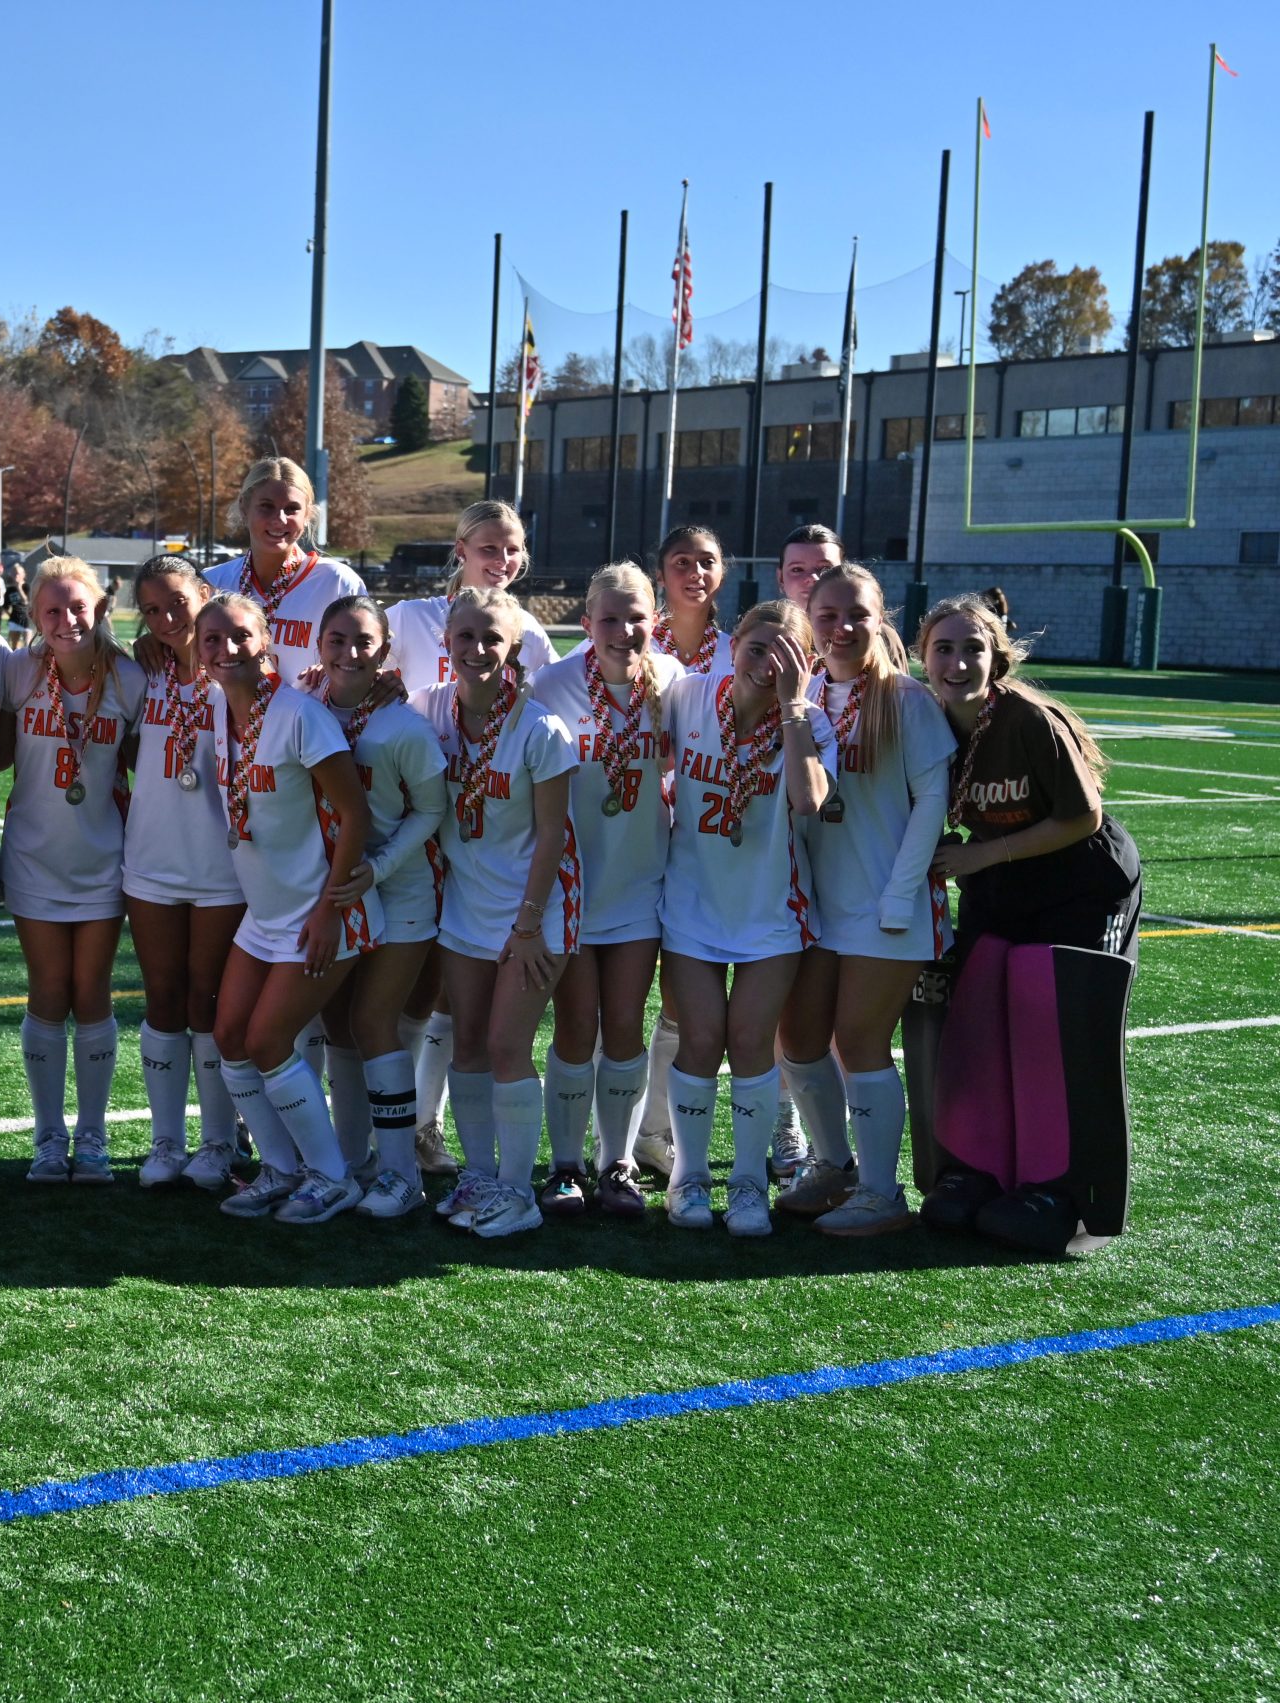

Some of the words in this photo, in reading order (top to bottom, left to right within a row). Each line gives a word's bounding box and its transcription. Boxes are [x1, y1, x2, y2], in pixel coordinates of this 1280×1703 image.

[24, 708, 117, 744] FALSON
[681, 748, 779, 796] FALLON
[143, 1056, 173, 1071] STX
[558, 1090, 588, 1100] STX
[608, 1086, 641, 1097] STX
[371, 1104, 409, 1117] APTAIN
[676, 1104, 708, 1116] STX
